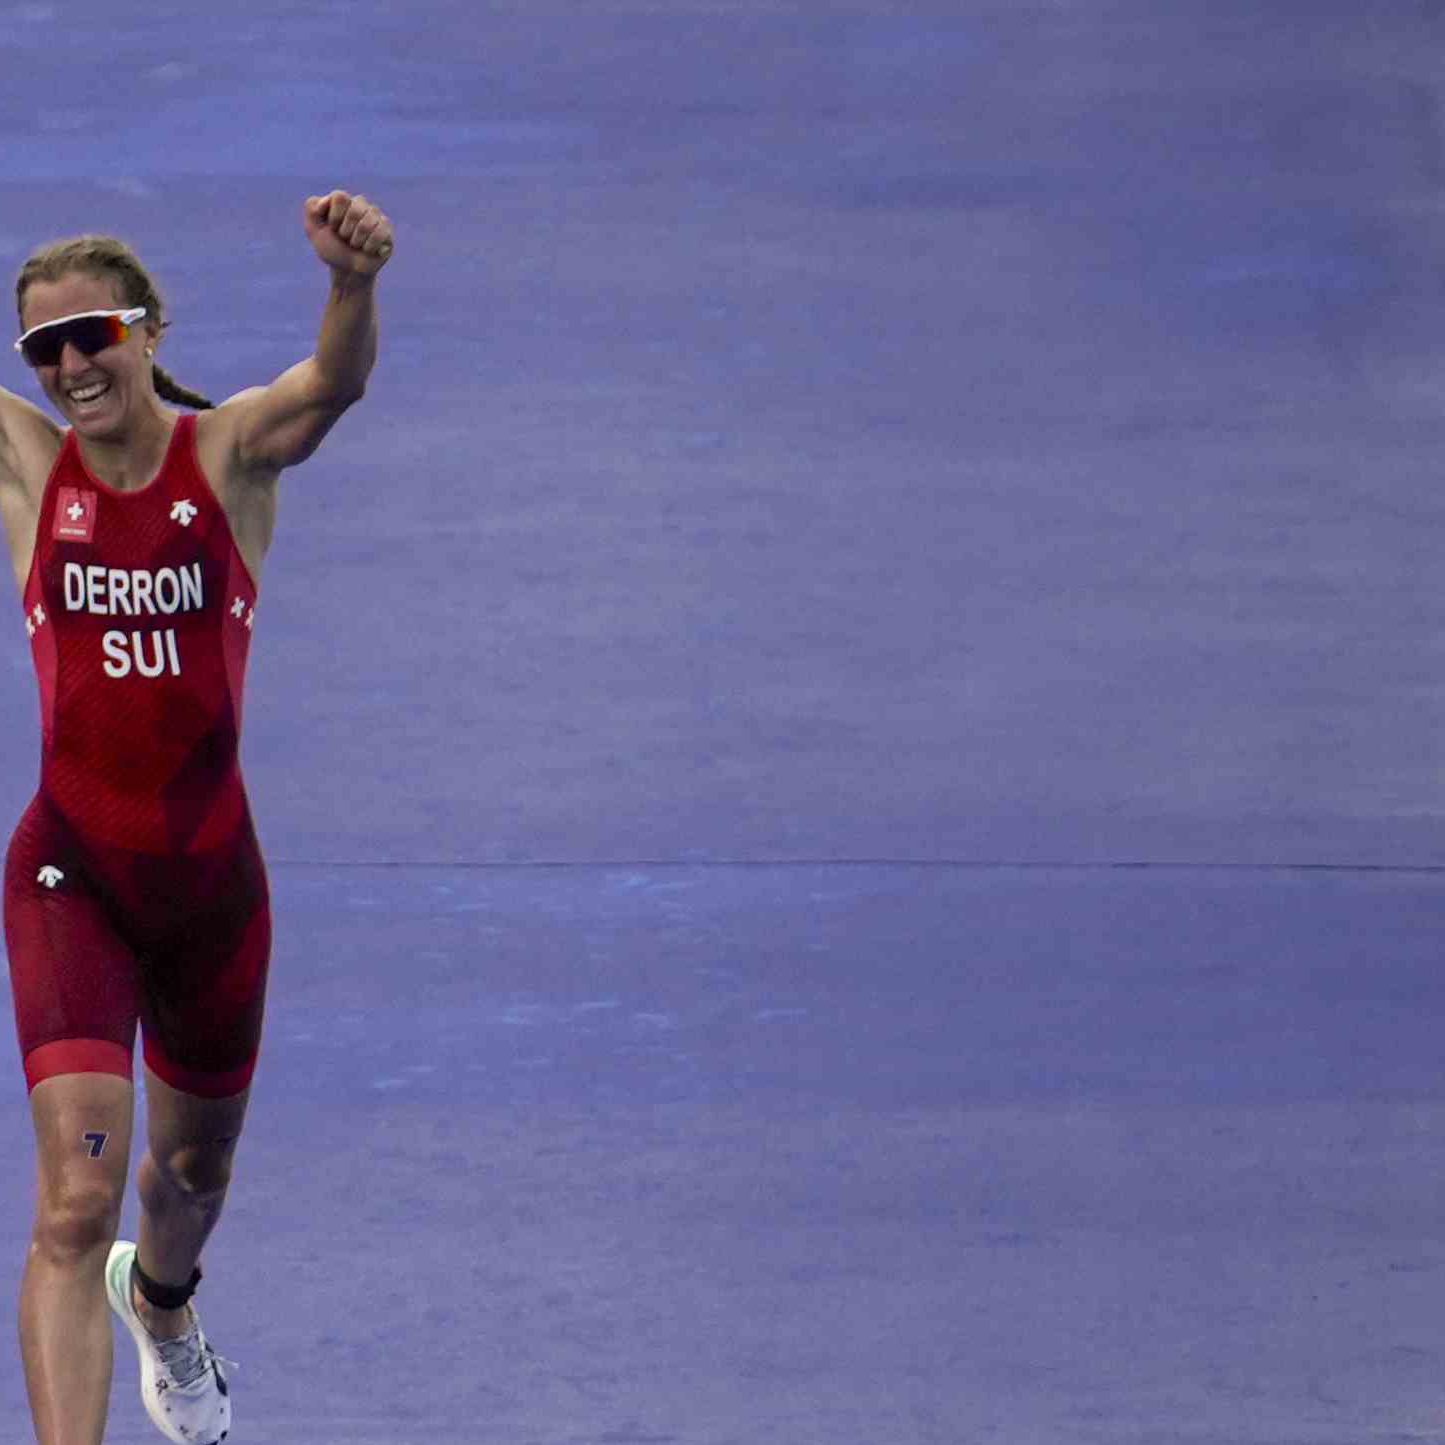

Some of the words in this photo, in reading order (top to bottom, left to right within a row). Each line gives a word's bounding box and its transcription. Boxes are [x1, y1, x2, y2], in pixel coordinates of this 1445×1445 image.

[64, 562, 203, 616] DERRON
[102, 628, 181, 678] SUI
[83, 1131, 108, 1159] 7
